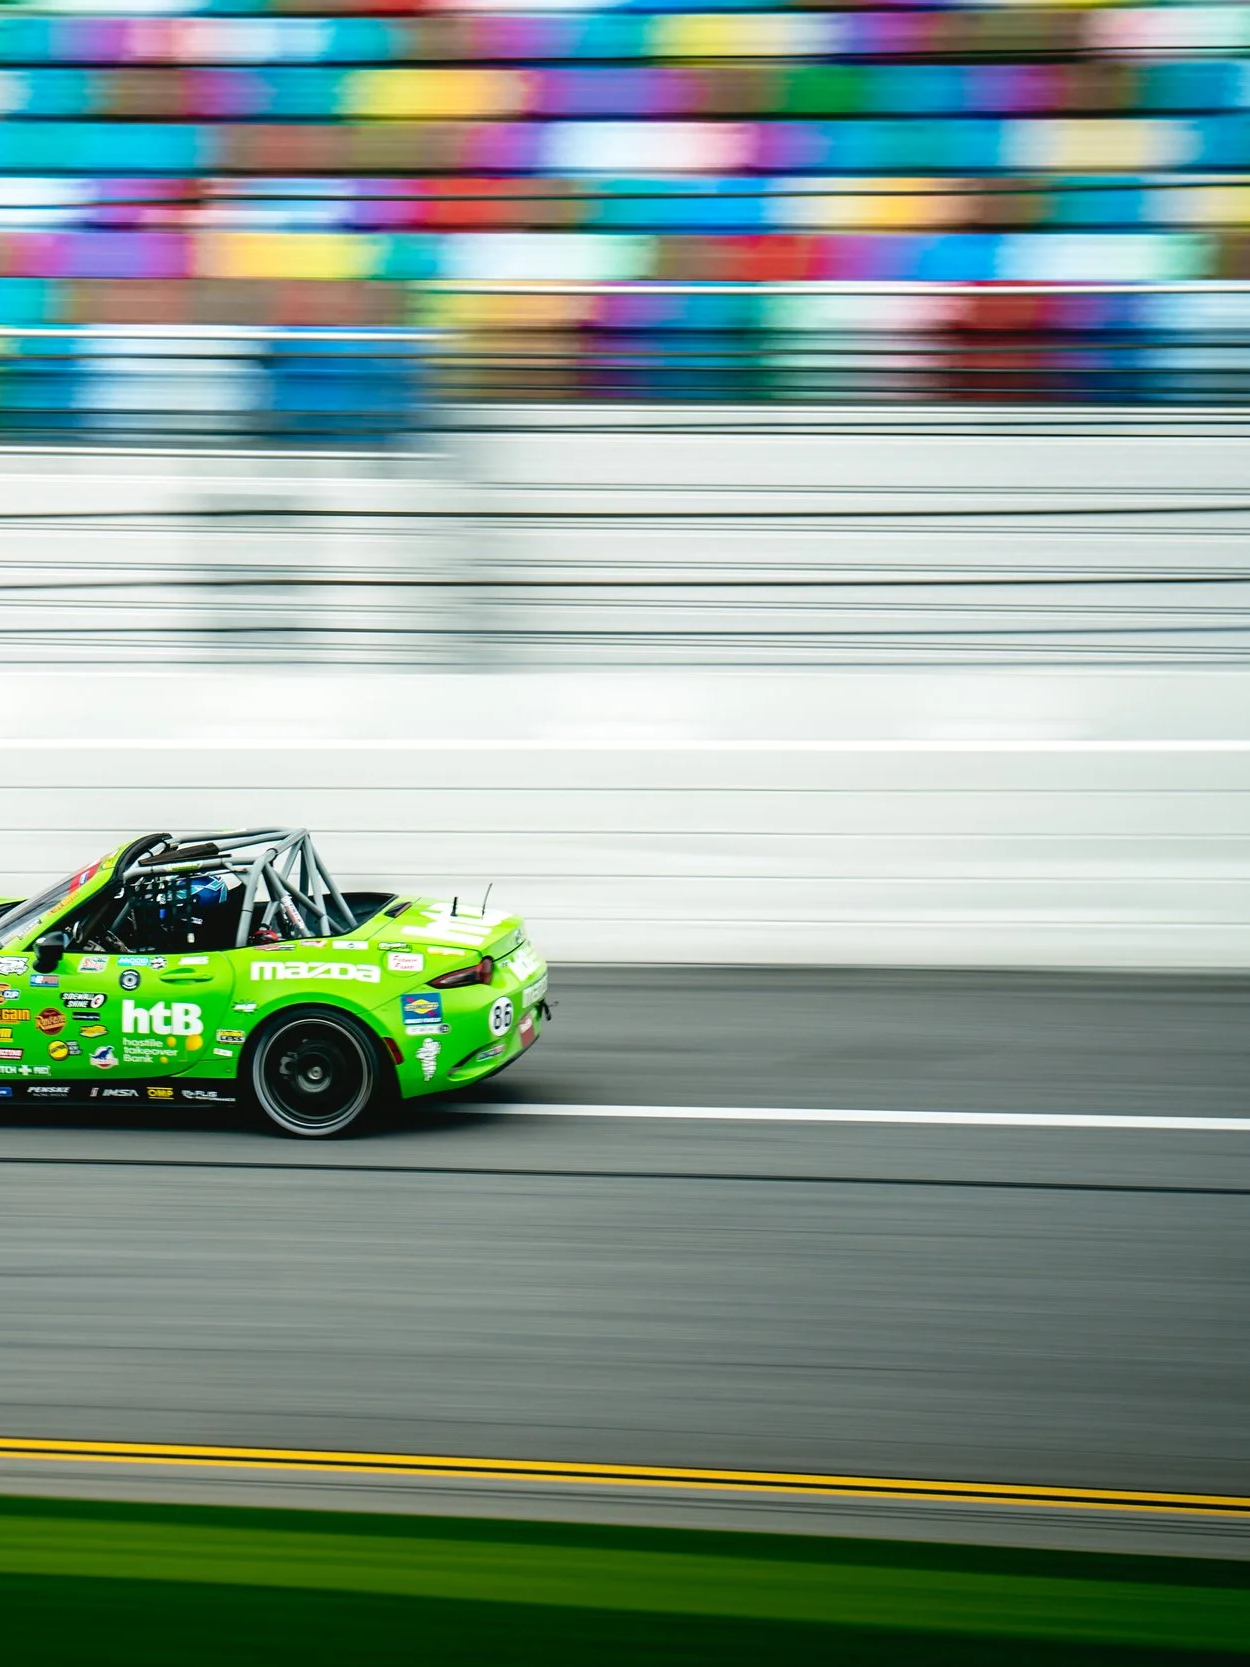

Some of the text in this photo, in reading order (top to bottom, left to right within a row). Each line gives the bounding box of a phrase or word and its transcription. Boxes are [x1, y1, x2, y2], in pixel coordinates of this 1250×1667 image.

[251, 961, 381, 983] mazda
[122, 1000, 204, 1035] htB
[493, 1002, 512, 1030] 86
[122, 1037, 163, 1048] hostile
[123, 1047, 178, 1056] takeover
[123, 1054, 153, 1063] Bank
